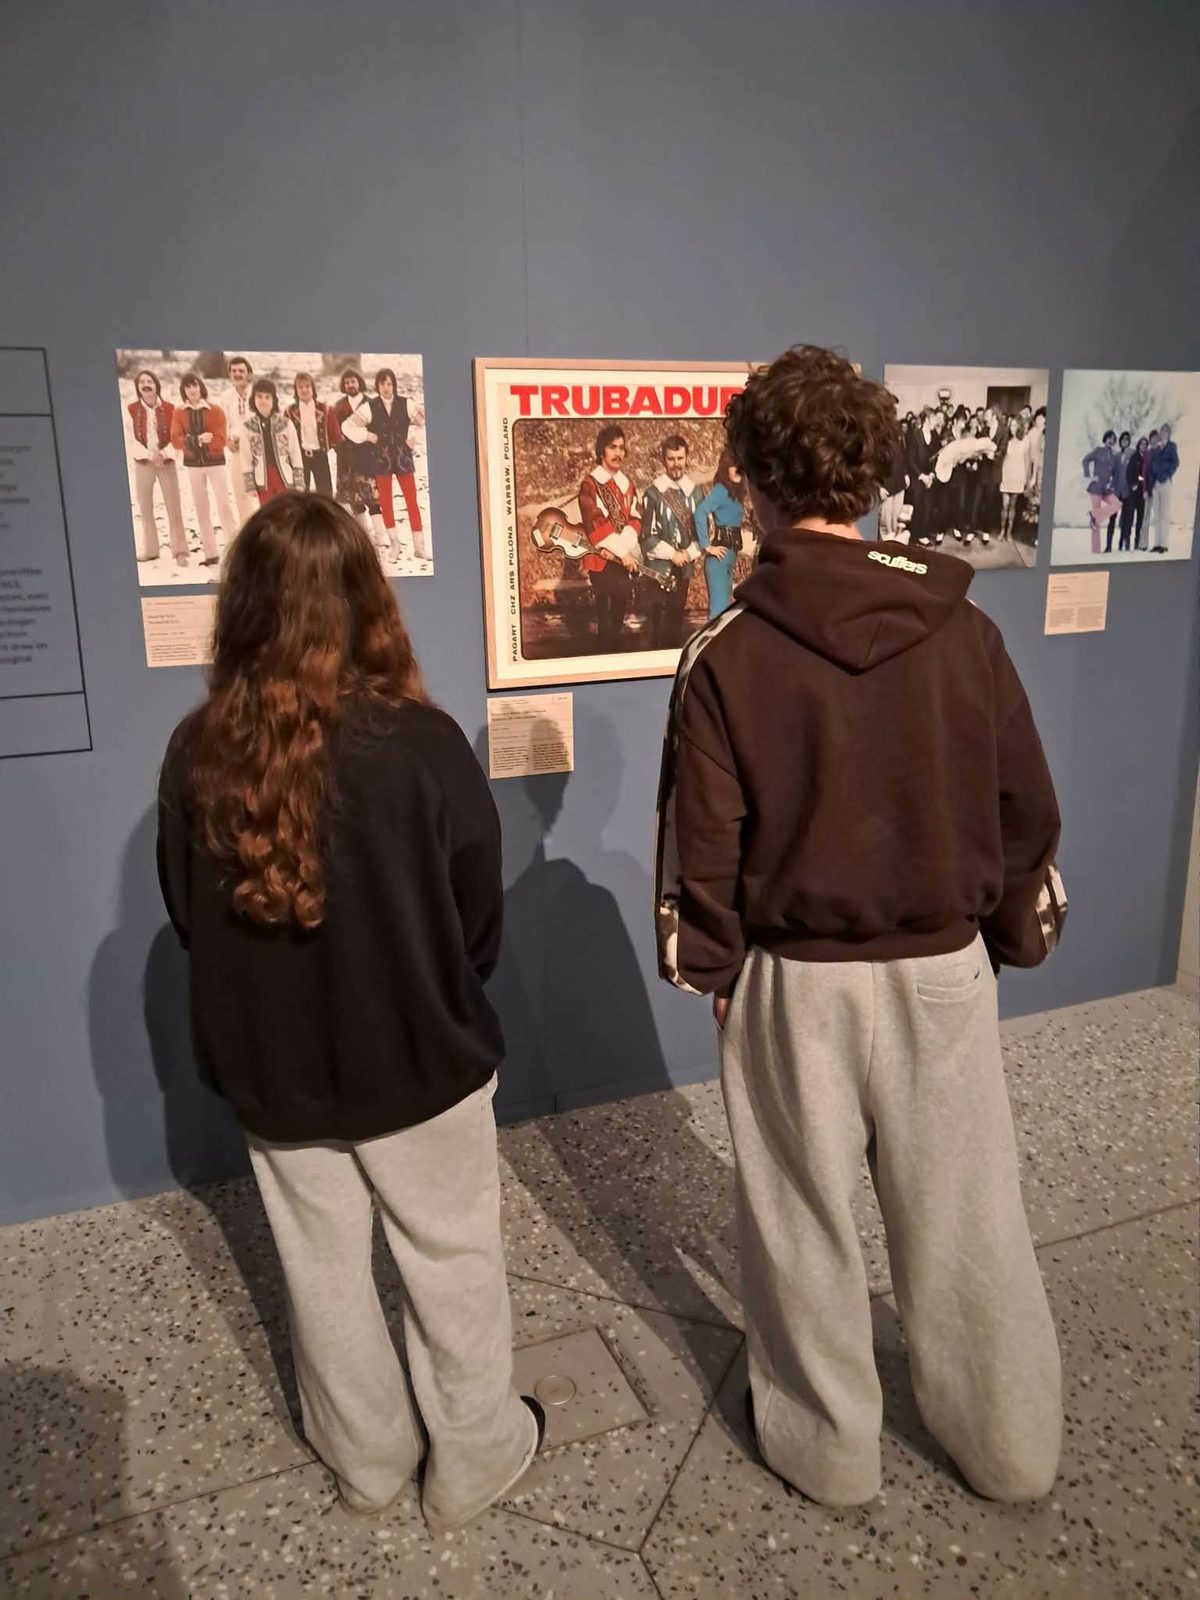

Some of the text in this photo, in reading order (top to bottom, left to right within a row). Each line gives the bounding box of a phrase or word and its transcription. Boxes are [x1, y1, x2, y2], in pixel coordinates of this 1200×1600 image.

[502, 417, 510, 460] POLAND
[504, 464, 513, 515] WARSAW,
[507, 526, 515, 566] POLONA
[867, 550, 928, 575] scuffers
